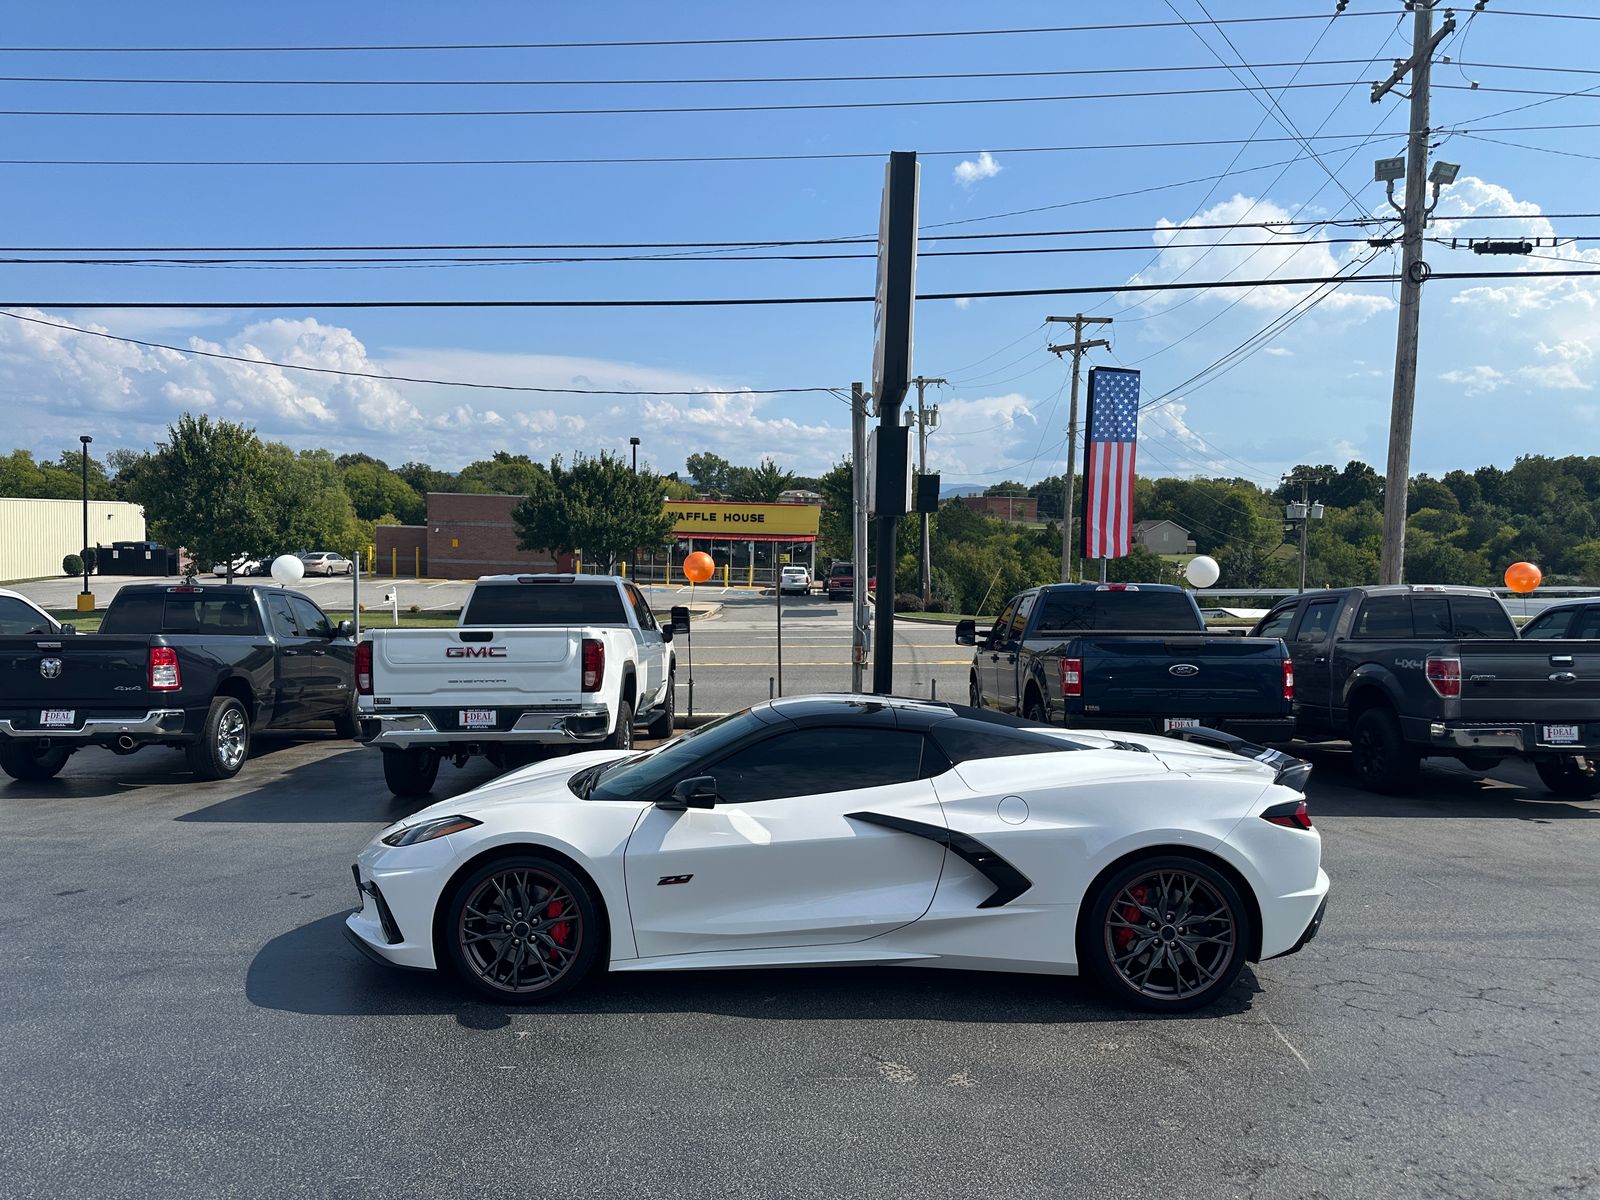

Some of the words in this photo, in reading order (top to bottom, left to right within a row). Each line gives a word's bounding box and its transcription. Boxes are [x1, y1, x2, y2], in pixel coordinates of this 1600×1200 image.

[723, 513, 765, 522] HOUSE
[446, 647, 507, 657] GMC
[1395, 658, 1423, 669] 4X4
[44, 712, 71, 722] I-DEAL
[463, 712, 493, 723] I-DEAL
[1547, 728, 1574, 738] I-DEAL
